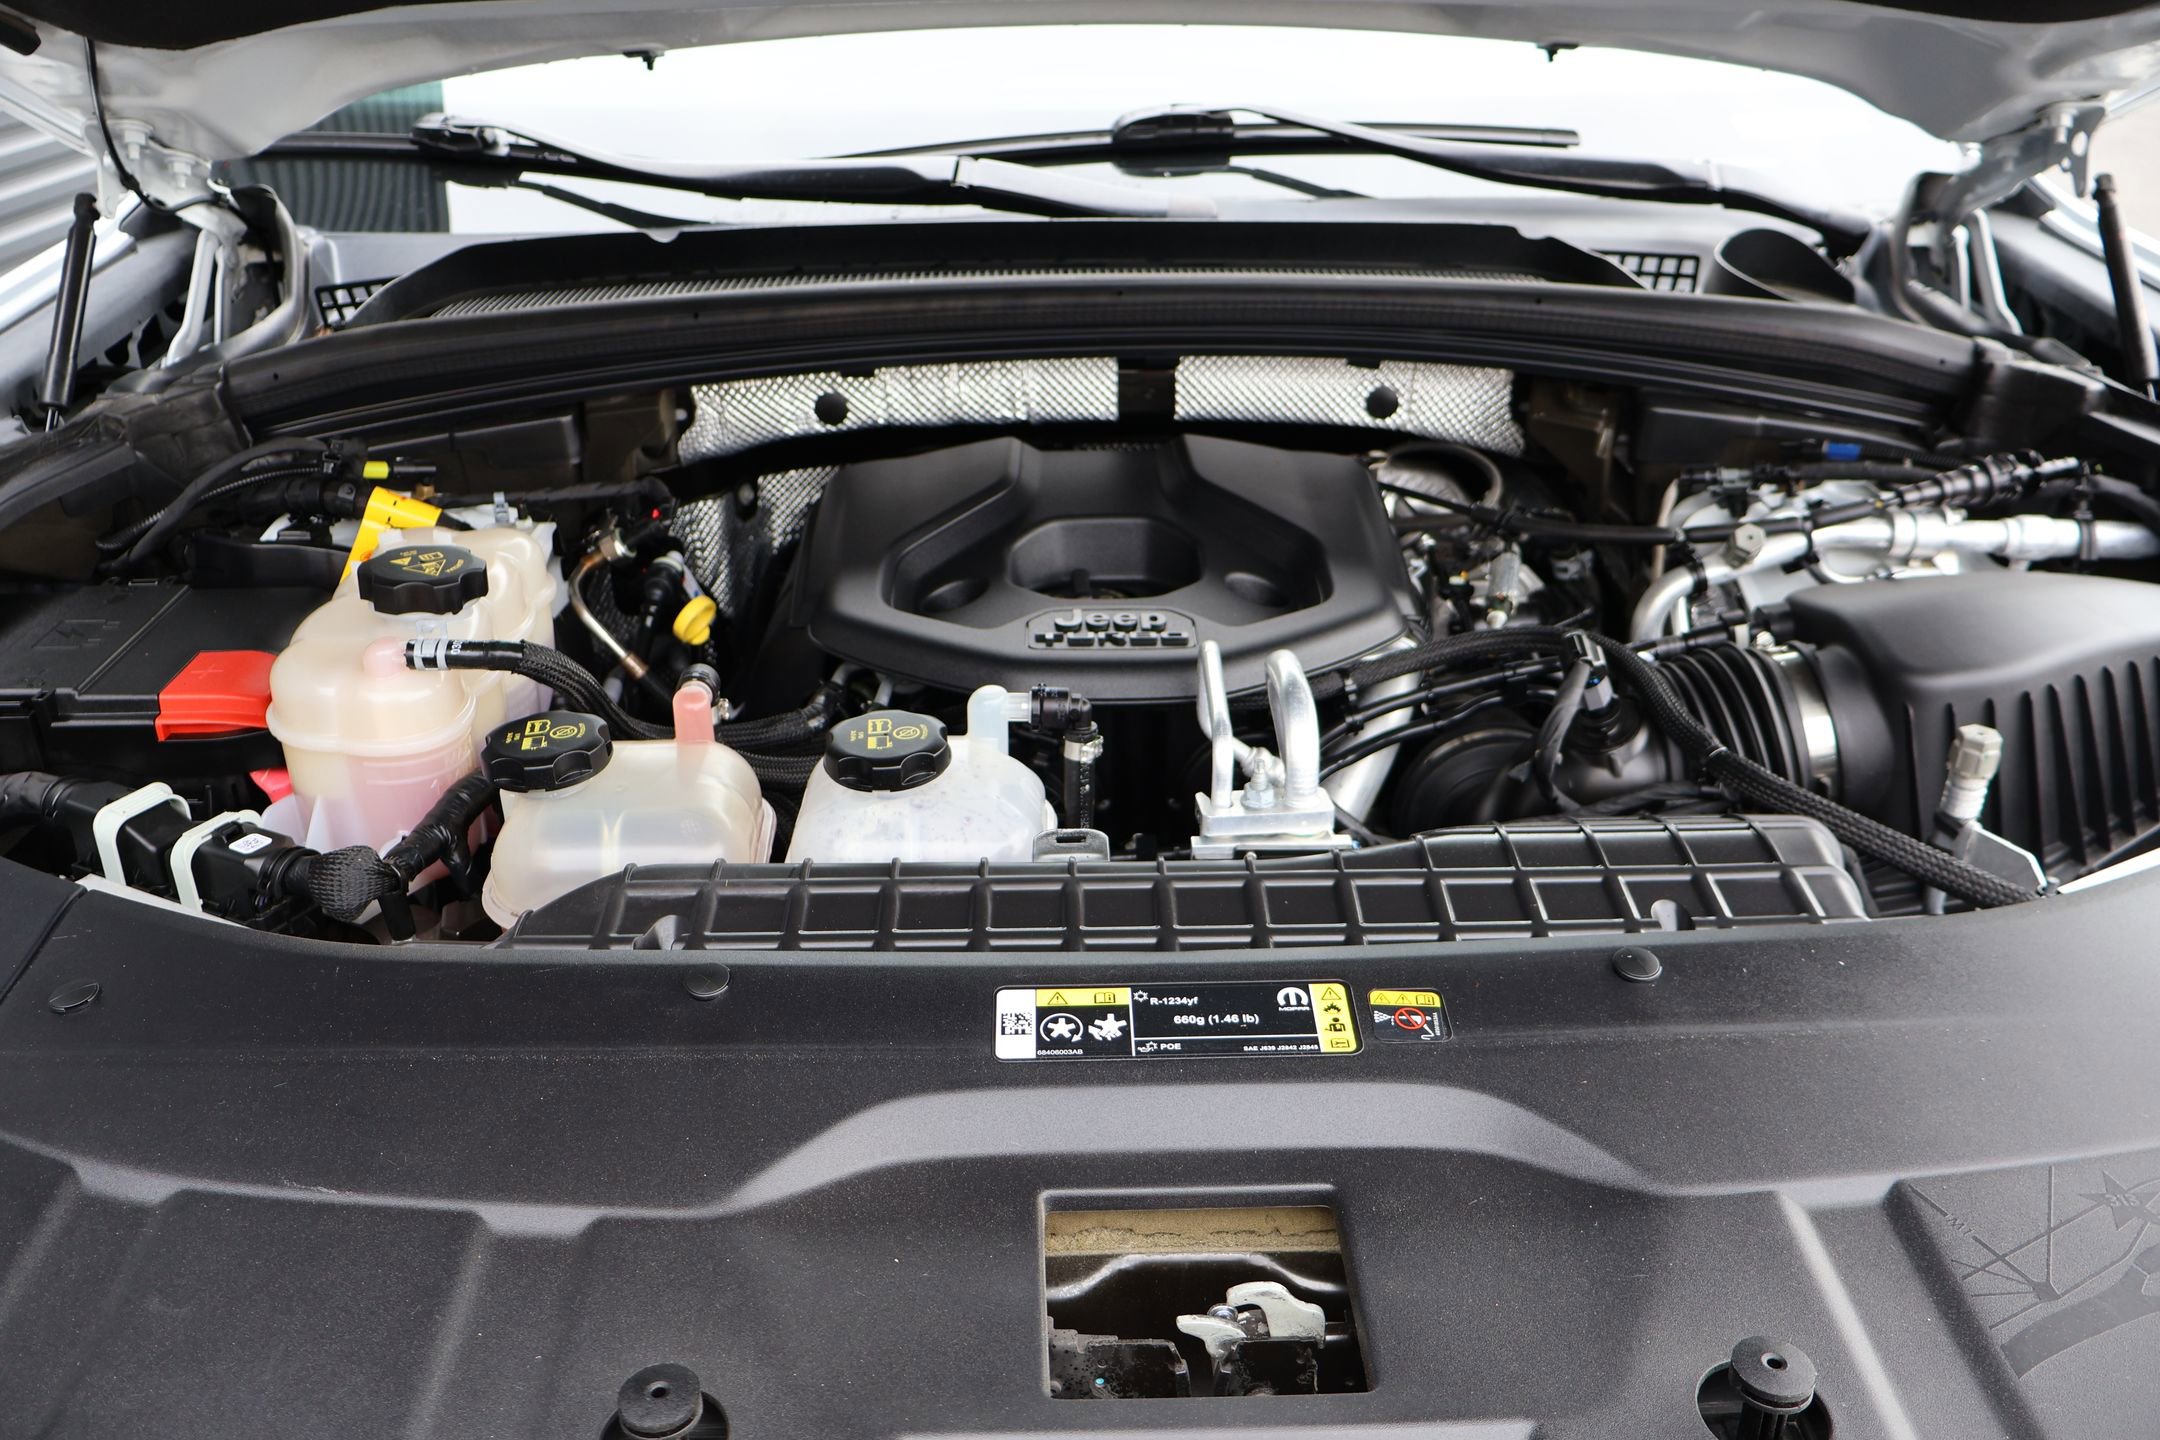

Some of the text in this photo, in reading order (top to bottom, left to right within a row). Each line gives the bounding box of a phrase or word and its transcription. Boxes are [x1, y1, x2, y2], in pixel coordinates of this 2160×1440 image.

[1054, 608, 1167, 632] Jeep
[1150, 996, 1199, 1006] R-1234yf
[1173, 1013, 1260, 1026] 660g (1.46 lb)
[1160, 1042, 1182, 1050] POE
